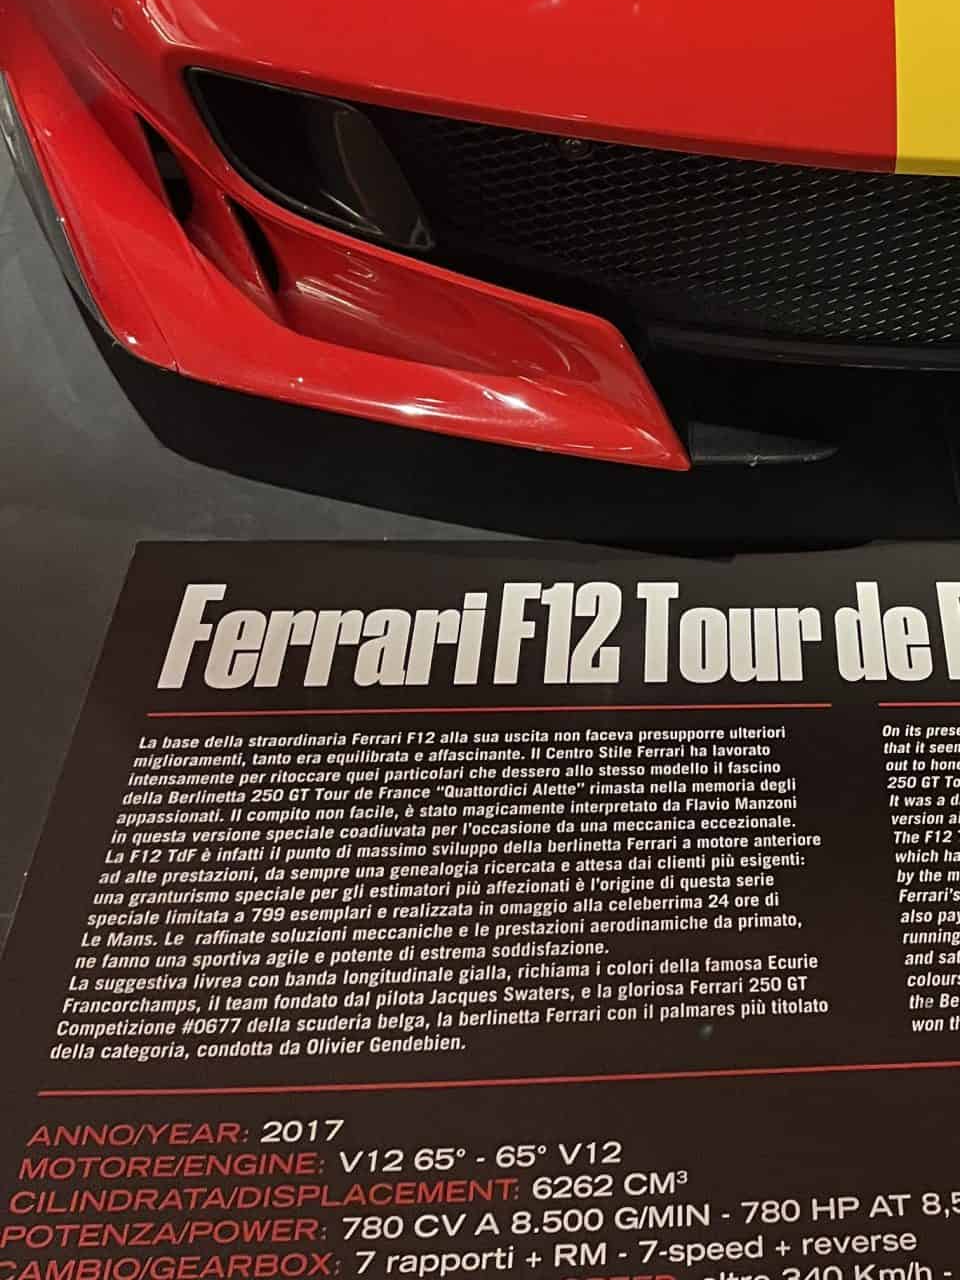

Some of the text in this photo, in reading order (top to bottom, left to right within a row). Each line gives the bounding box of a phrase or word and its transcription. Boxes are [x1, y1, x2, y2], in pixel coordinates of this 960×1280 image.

[157, 584, 488, 689] Ferrari
[493, 582, 622, 685] F12
[636, 582, 822, 683] Tour
[834, 581, 933, 681] de
[138, 725, 786, 750] La base della straordinaria Ferrari F12 alla sua uscita non faceva presupporre ulteriori
[882, 724, 901, 737] On
[904, 724, 922, 737] its
[115, 795, 797, 827] appassionati. Il compito non facile, è stato magicamente interpretato da Flavio Manzoni
[891, 811, 944, 825] version
[87, 892, 779, 929] speciale limitata a 799 esemplari e realizzata in omaggio alla celeberrima 24 ore di
[911, 1018, 944, 1032] won
[49, 1033, 466, 1063] della categoria, condotta da Olivier Gendebien.
[27, 1120, 344, 1146] ANNO/YEAR: 2017
[19, 1153, 323, 1179] MOTORE/ENGINE:
[340, 1150, 403, 1172] V12
[559, 1142, 621, 1164] V12
[9, 1179, 519, 1214] CILINDRATA/DISPLACEMENT:
[533, 1175, 613, 1199] 6262
[0, 1220, 325, 1248] POTENZA/POWER:
[343, 1216, 403, 1239] 780
[415, 1214, 466, 1237] CV
[475, 1213, 499, 1235] A
[512, 1209, 603, 1234] 8.500
[615, 1204, 709, 1229] G/MIN
[741, 1200, 800, 1223] 780
[812, 1197, 859, 1220] HP
[870, 1194, 911, 1217] AT
[356, 1251, 376, 1274] 7
[387, 1246, 513, 1272] rapporti
[555, 1243, 606, 1267] RM
[639, 1235, 763, 1264] 7-speed
[803, 1233, 916, 1255] reverse
